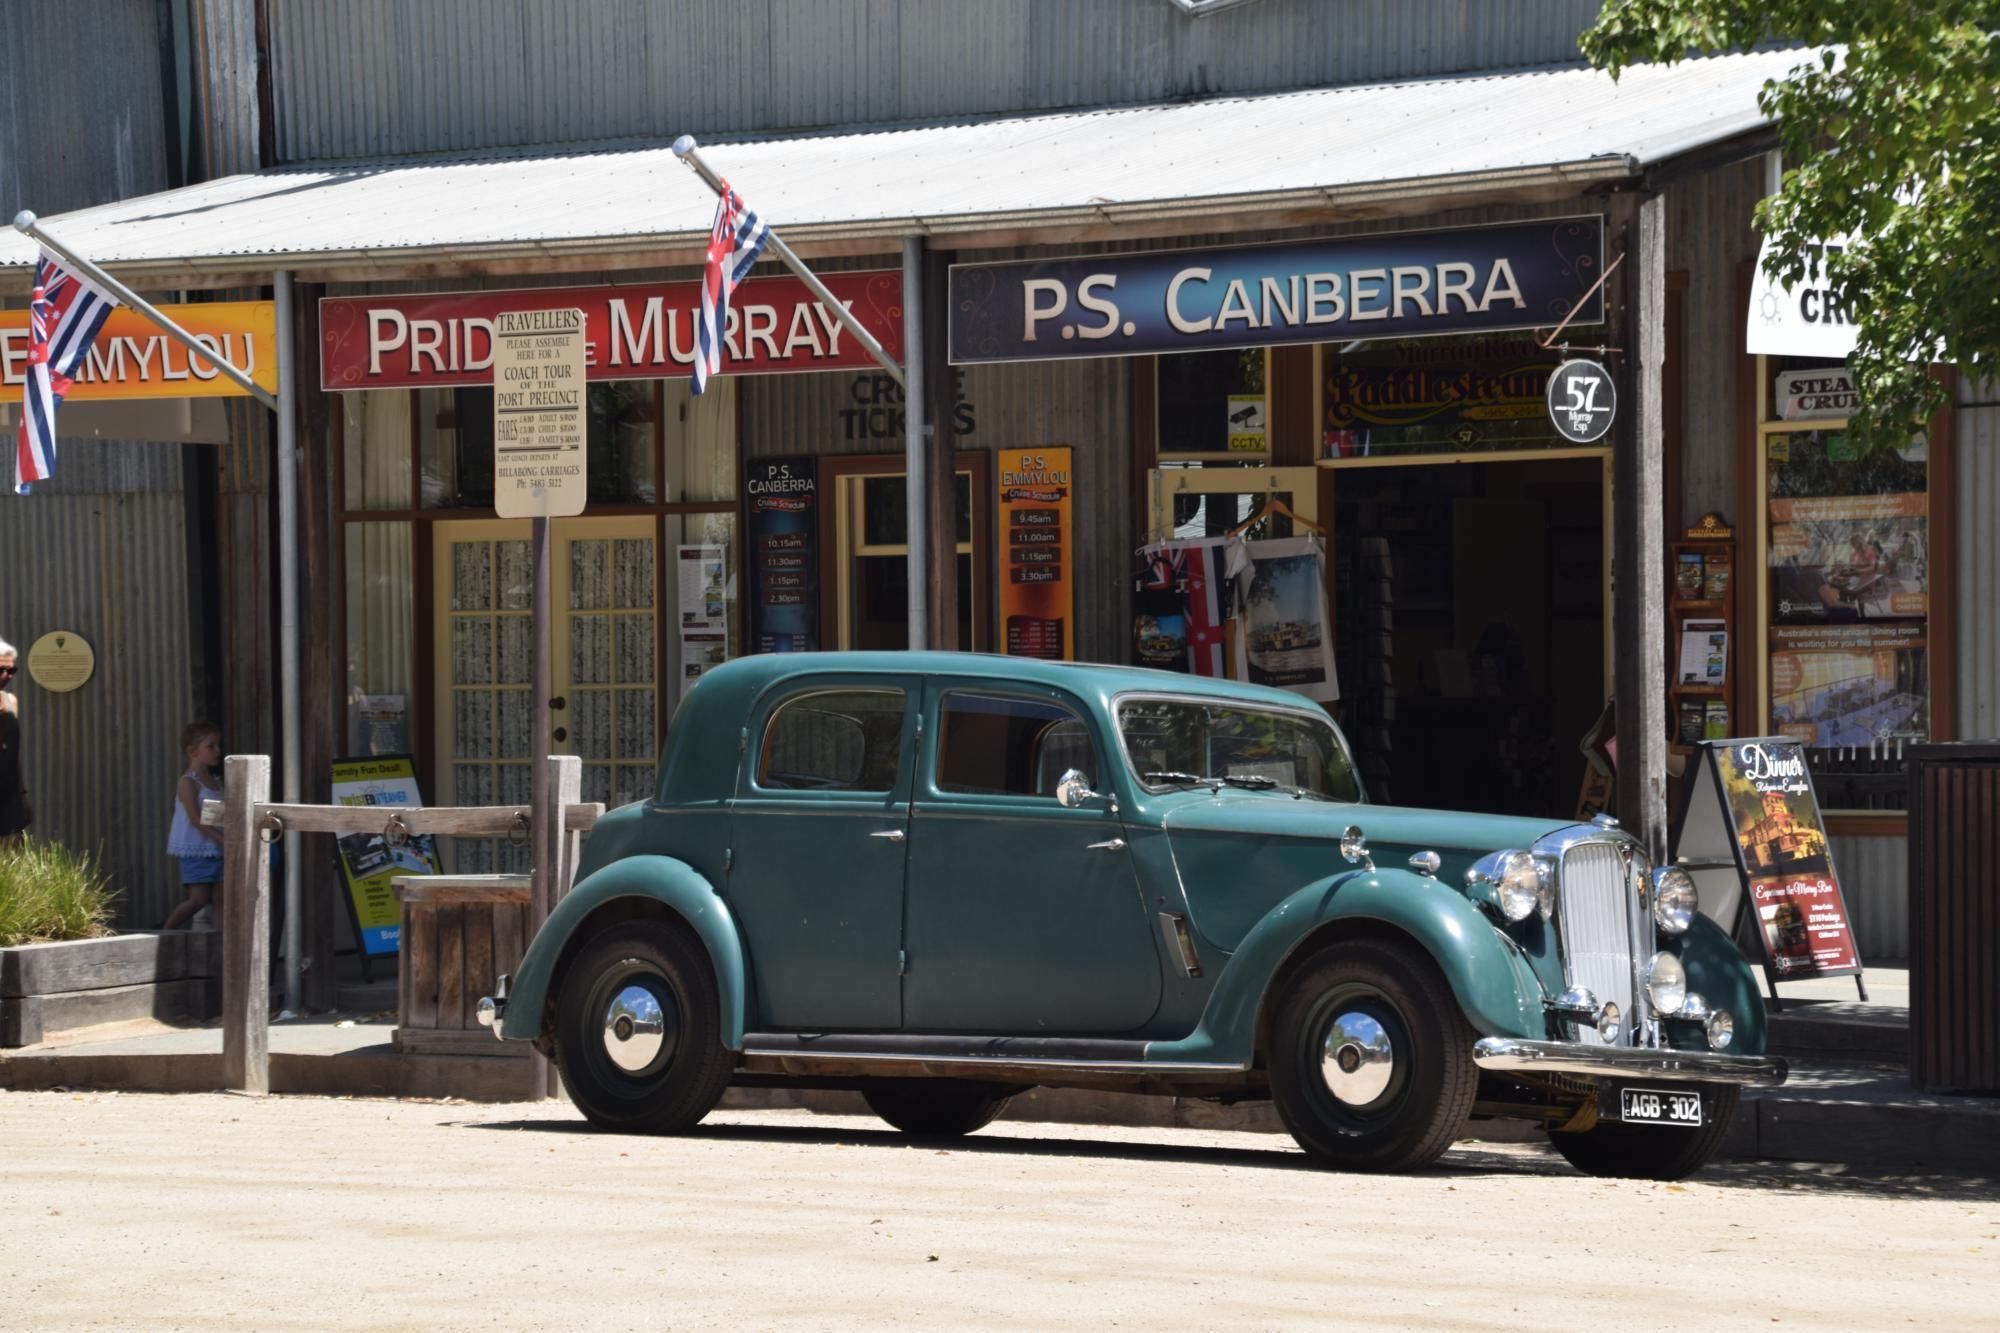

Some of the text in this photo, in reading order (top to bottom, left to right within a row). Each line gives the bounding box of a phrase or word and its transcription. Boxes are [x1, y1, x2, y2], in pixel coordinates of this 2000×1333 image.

[1021, 258, 1527, 342] P.S. CANBERRA
[498, 310, 579, 331] TRAVELLERS
[368, 308, 495, 374] PRID
[506, 336, 571, 349] PLEASE ASSEMBLE
[1, 327, 255, 386] EMYLOU
[516, 348, 561, 361] HERE FOR A
[504, 364, 571, 381] COACH TOUR
[520, 380, 557, 390] OF THE
[497, 390, 579, 407] PORT PRECINCT
[1566, 376, 1601, 412] 57
[538, 414, 557, 422] ADULT
[839, 403, 976, 440] TICKS
[1568, 411, 1594, 424] Murray
[498, 419, 518, 441] FARES
[538, 424, 556, 433] CHILD
[538, 435, 560, 444] FAMILY
[1231, 438, 1262, 449] CCTV
[1022, 455, 1048, 470] P.S.
[498, 465, 580, 477] BILLABONG CARRIAGES
[768, 464, 793, 480] P.S.
[1003, 471, 1068, 486] EMMYLOU
[748, 479, 815, 494] CANBERRA
[1019, 514, 1052, 523] 9.45am
[768, 539, 802, 548] 10.15am
[1018, 533, 1055, 542] 11.00am
[767, 558, 802, 566] 11.30am
[1021, 552, 1052, 562] 1.15pm
[770, 577, 799, 586] 1.15pm
[1777, 629, 1819, 638] Australia's
[1871, 627, 1896, 636] dining
[1898, 627, 1920, 635] room
[1797, 639, 1826, 648] waiting
[1828, 639, 1839, 647] for
[1840, 640, 1856, 649] you
[1741, 744, 1804, 780] Dinner
